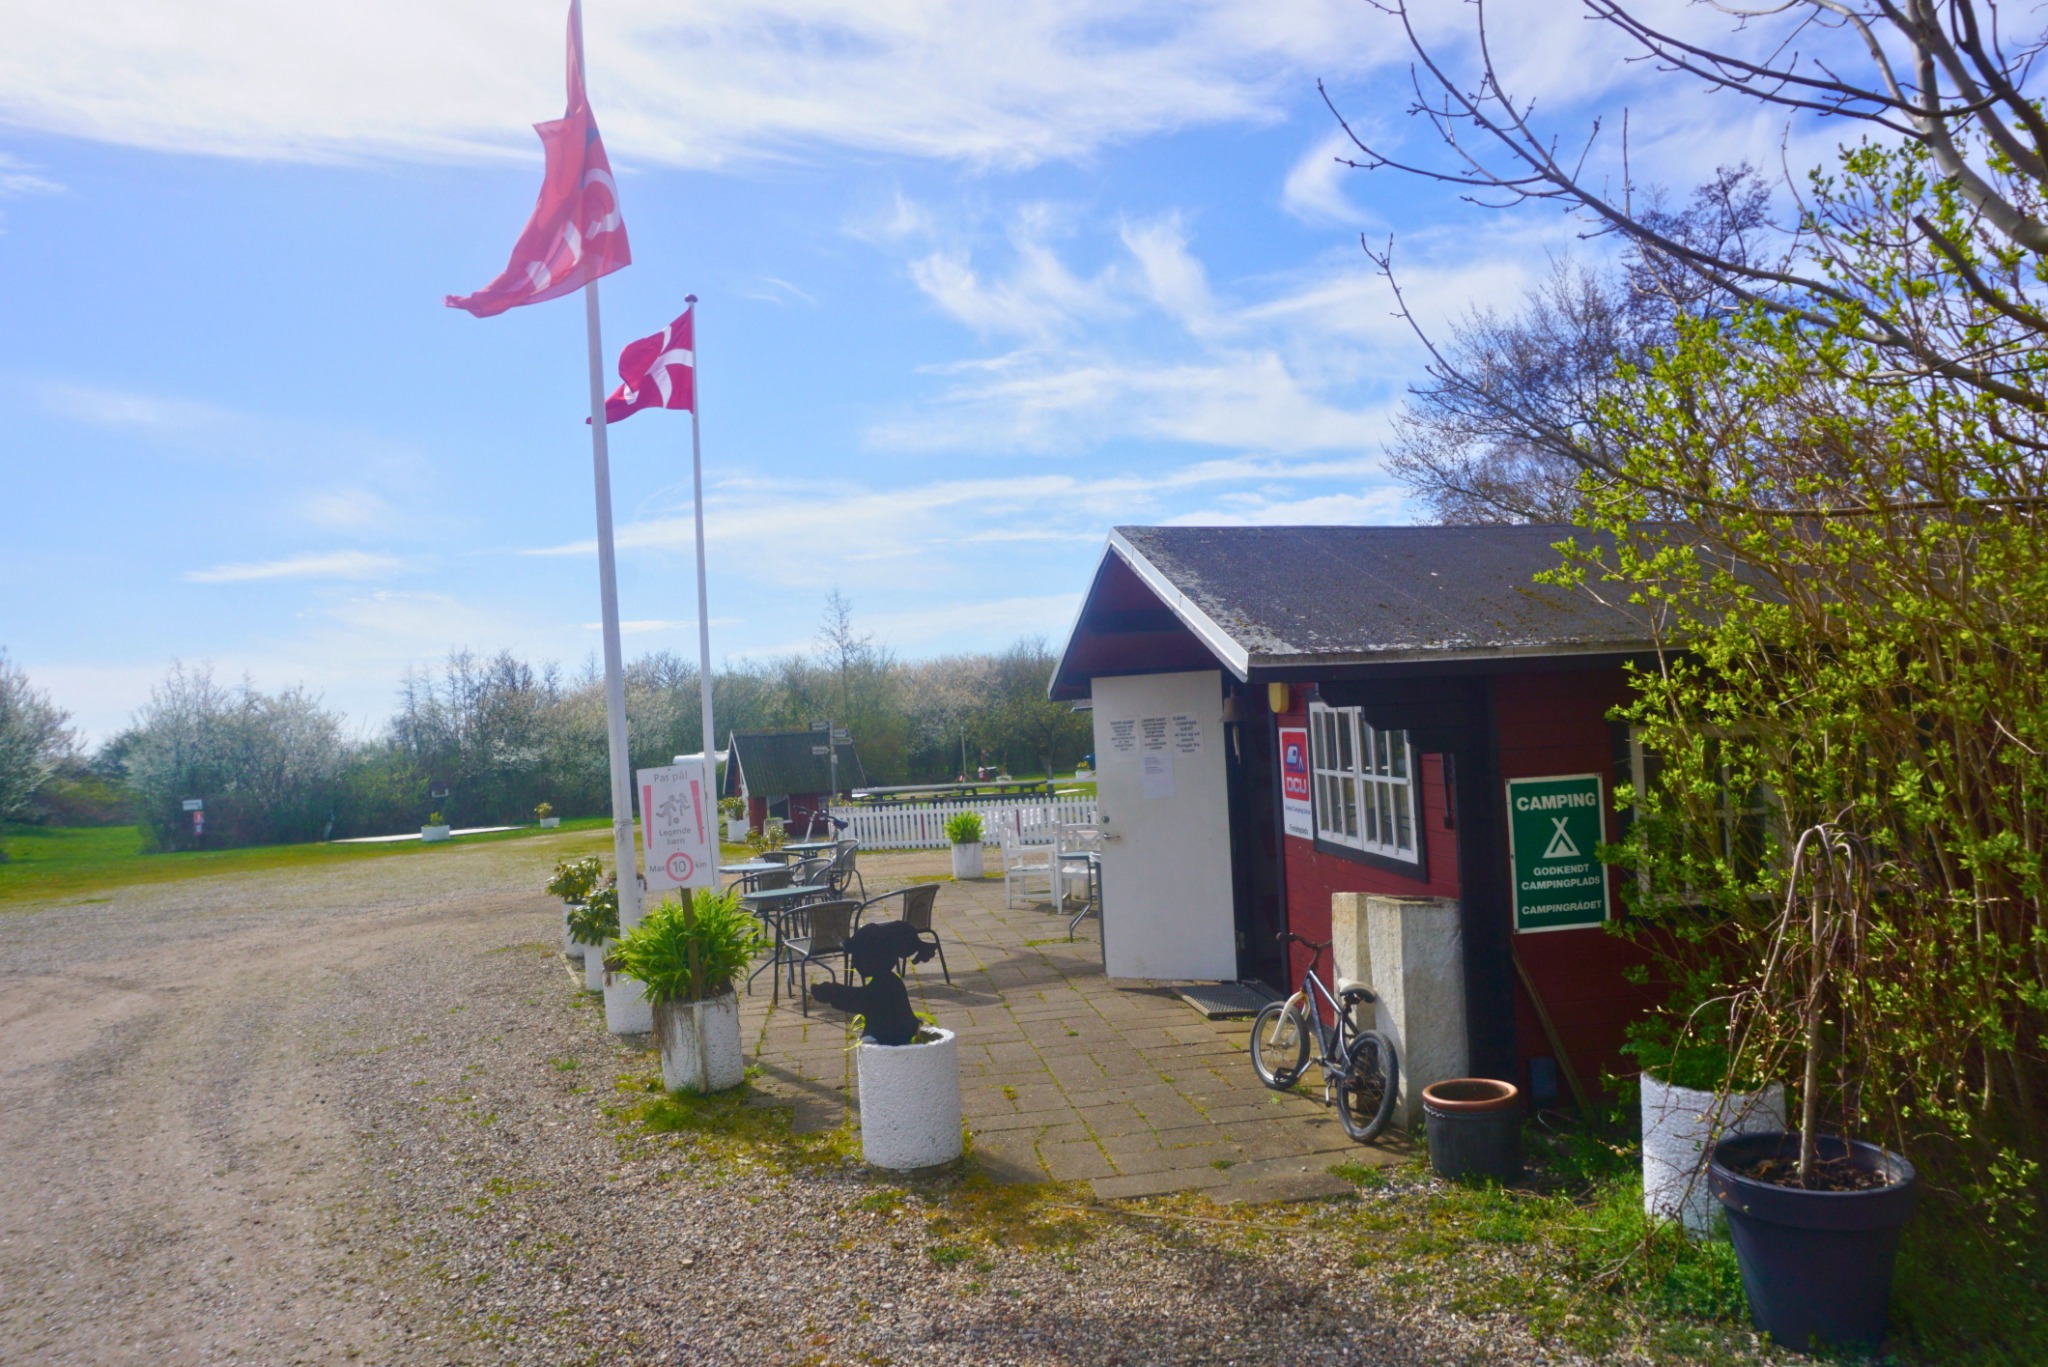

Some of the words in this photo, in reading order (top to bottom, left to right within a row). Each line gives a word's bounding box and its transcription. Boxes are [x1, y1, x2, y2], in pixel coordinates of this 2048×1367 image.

[1286, 776, 1307, 794] DCU
[1516, 792, 1596, 811] CAMPING
[658, 826, 692, 837] Legende
[649, 864, 665, 873] Max
[673, 861, 687, 872] 10
[695, 861, 707, 869] km
[1533, 863, 1590, 876] GODKENDT
[1521, 876, 1600, 890] CAMPINGPLADS
[1522, 900, 1602, 915] CAMPINGRÅDET
